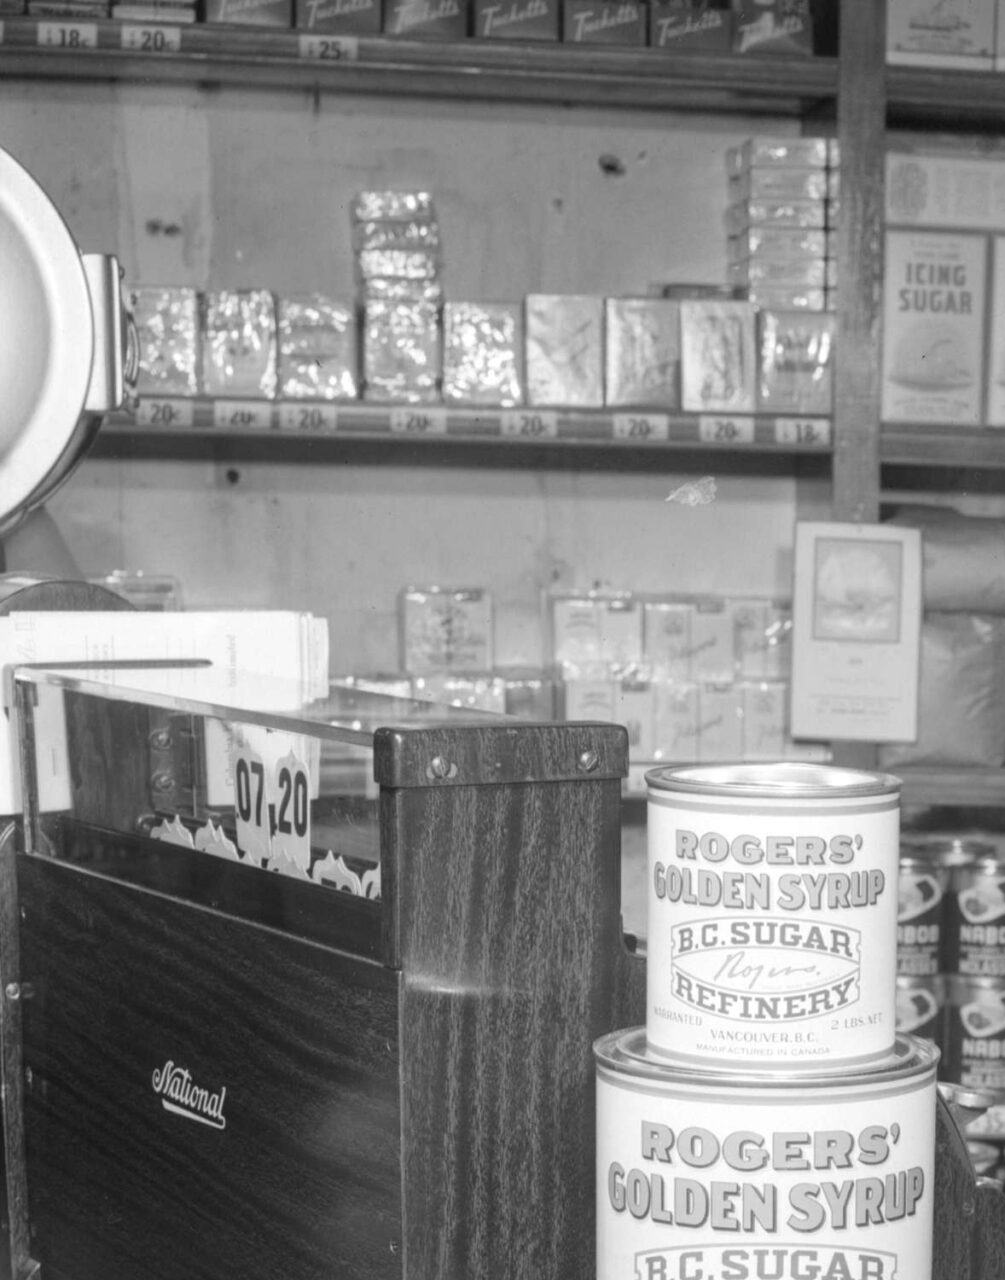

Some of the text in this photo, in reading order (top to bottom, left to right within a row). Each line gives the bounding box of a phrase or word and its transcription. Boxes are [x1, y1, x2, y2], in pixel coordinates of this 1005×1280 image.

[906, 262, 966, 287] ICING
[899, 289, 973, 315] SUGAR
[675, 828, 864, 866] ROGERS'
[653, 861, 886, 911] GOLDEN SYRUP
[678, 921, 854, 958] B.C. SUGAR
[674, 971, 856, 1020] REFINERY
[830, 1019, 840, 1030] 2
[695, 1042, 831, 1057] MANUFACTURED IN CANADA
[152, 1060, 226, 1127] National
[641, 1119, 901, 1172] ROGERS'
[608, 1161, 925, 1234] GOLDEN SYRUP
